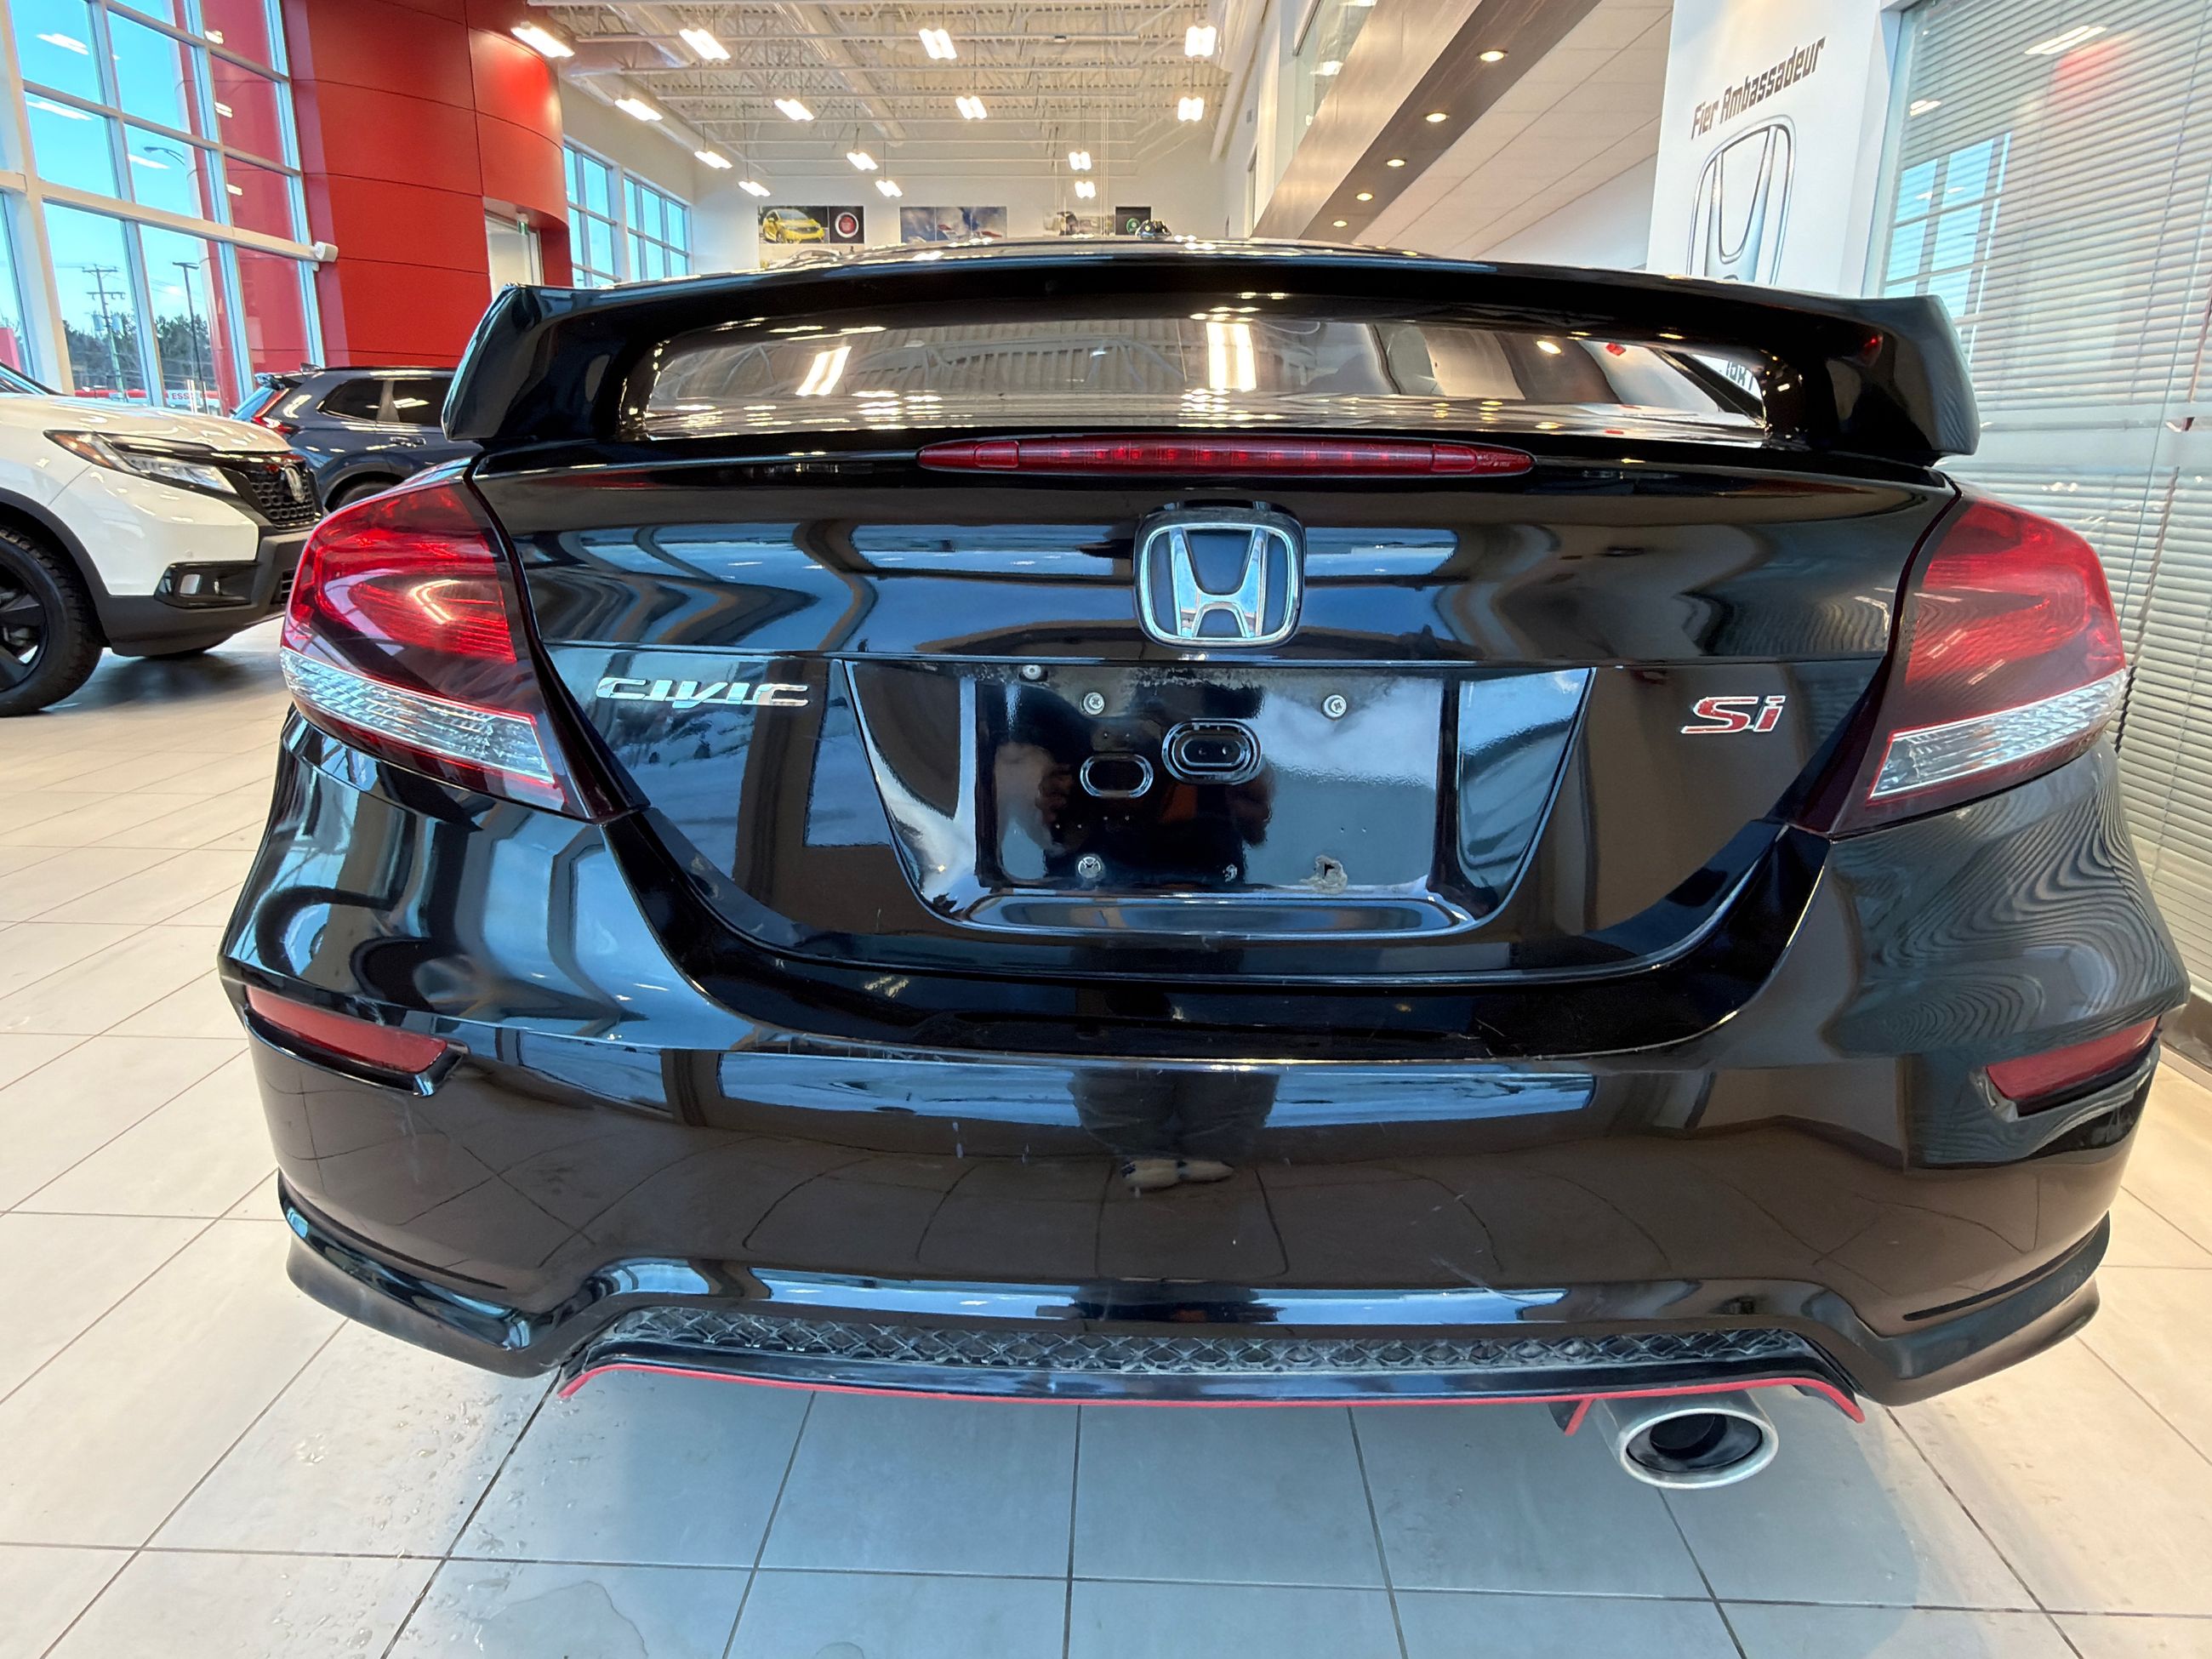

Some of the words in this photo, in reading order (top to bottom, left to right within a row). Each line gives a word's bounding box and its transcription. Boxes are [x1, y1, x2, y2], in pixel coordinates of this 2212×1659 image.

[1691, 100, 1719, 140] Fier
[1719, 36, 1827, 124] Ambassadeur
[596, 677, 809, 709] CIVIC
[1681, 694, 1787, 734] Si
